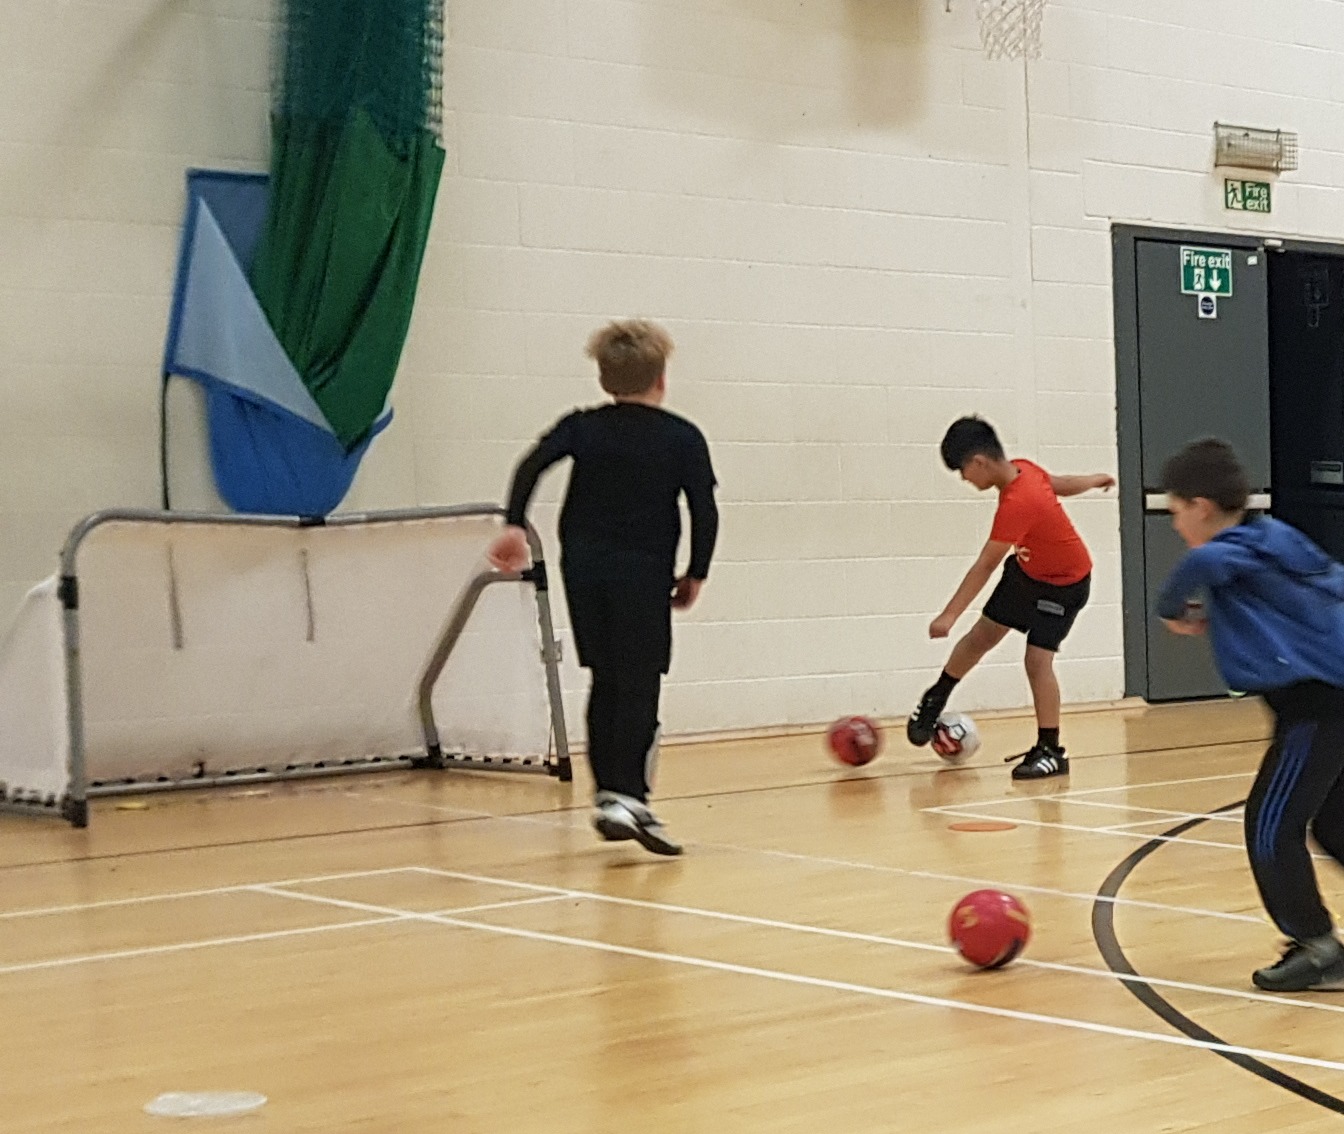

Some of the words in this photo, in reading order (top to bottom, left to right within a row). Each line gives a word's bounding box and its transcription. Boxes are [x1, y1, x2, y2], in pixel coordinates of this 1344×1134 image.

[1245, 182, 1268, 198] Fire
[1245, 198, 1269, 212] exit
[1183, 250, 1206, 267] Fire
[1207, 253, 1230, 270] exit
